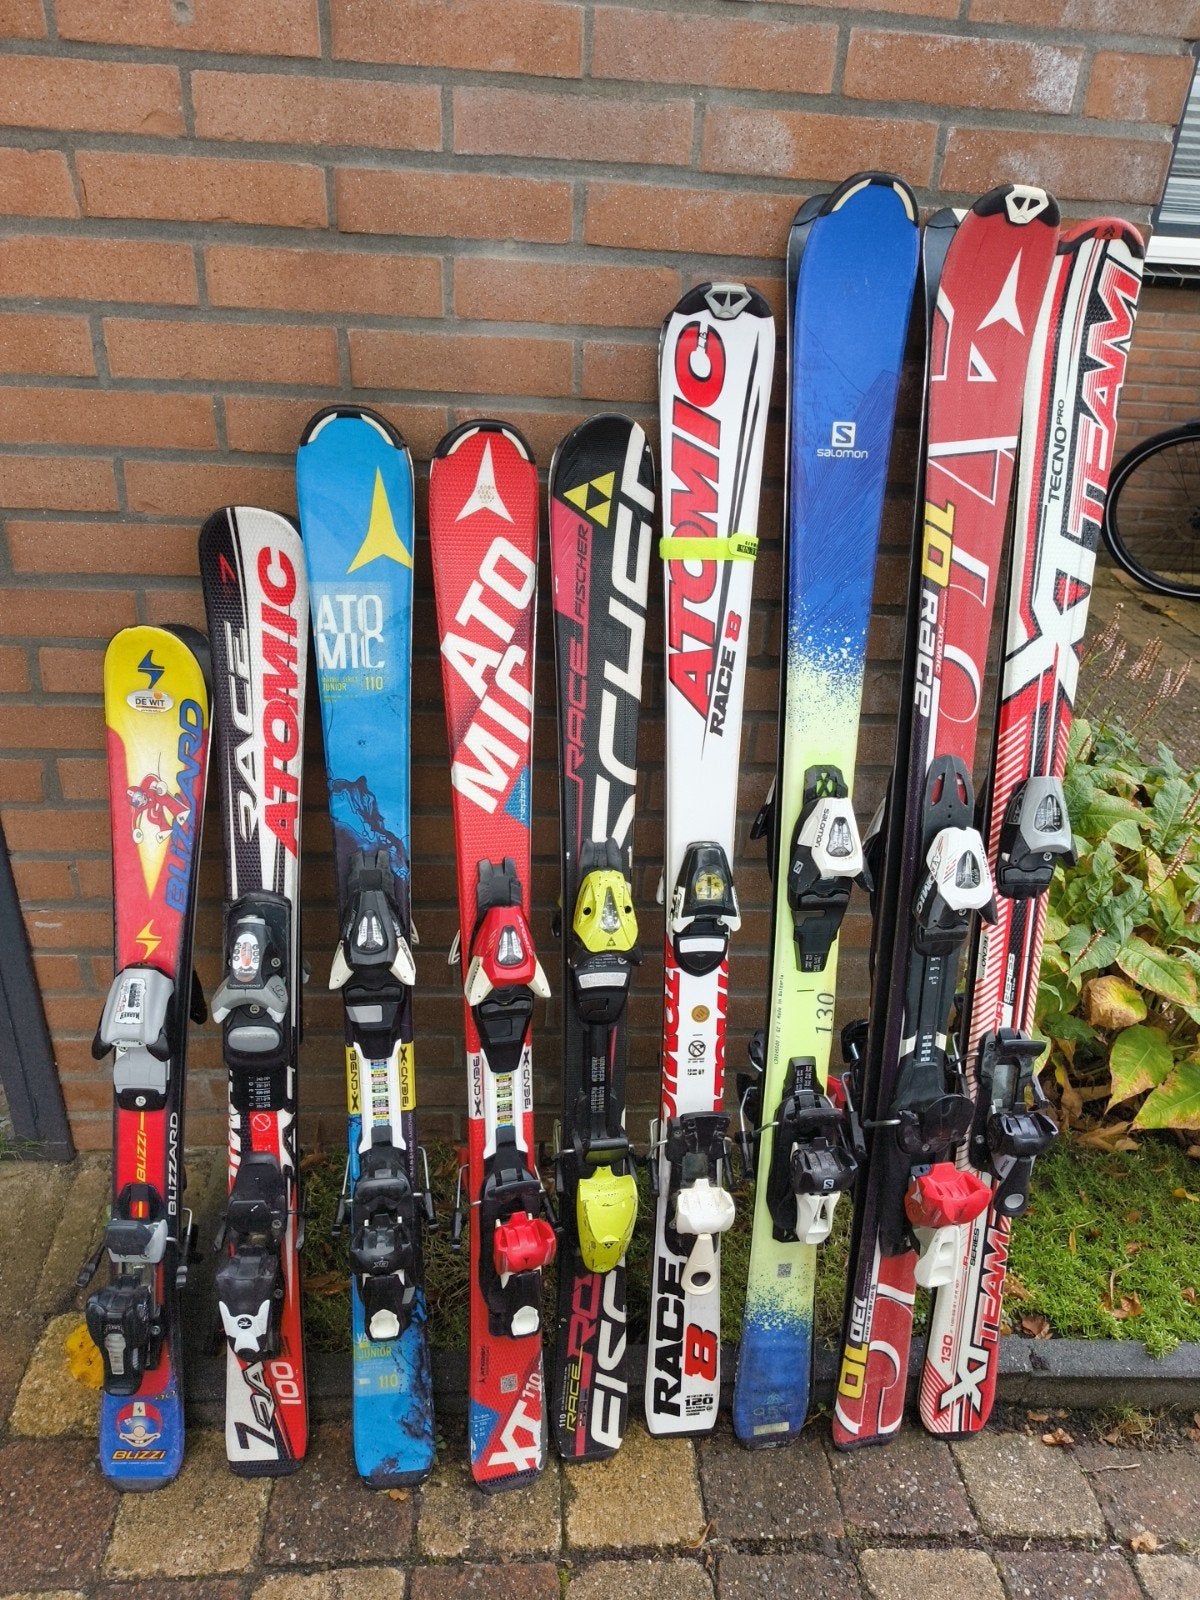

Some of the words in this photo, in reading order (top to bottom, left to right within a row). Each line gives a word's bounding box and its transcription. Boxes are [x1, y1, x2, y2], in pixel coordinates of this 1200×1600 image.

[1055, 398, 1066, 426] PRO
[1066, 266, 1144, 540] TEAM
[1047, 430, 1068, 503] TECNO
[668, 320, 727, 721] ATOMIC
[921, 500, 954, 588] 10
[576, 523, 590, 619] FISCHER
[314, 594, 384, 636] ATO
[441, 536, 537, 699] ATO
[317, 632, 385, 670] MIC
[934, 624, 945, 674] ATOMIC
[322, 682, 347, 692] JUNIOR
[365, 676, 384, 691] 110
[709, 644, 736, 737] RACE
[724, 610, 742, 641] 8
[150, 699, 165, 707] WIT
[257, 546, 299, 860] ATOMIC
[224, 621, 256, 843] RACE
[815, 991, 835, 1035] 130
[969, 1228, 980, 1267] SERIES
[976, 1225, 1011, 1347] TEAM
[652, 1256, 687, 1418] RACE
[684, 1322, 718, 1382] 8
[848, 1295, 866, 1343] 130
[359, 1347, 392, 1360] JUNIOR
[837, 1341, 869, 1399] 10
[941, 1335, 952, 1364] 130
[270, 1361, 302, 1405] 100
[379, 1374, 399, 1389] 110
[521, 1372, 542, 1401] 110
[566, 1360, 582, 1433] RACE
[684, 1397, 714, 1407] 120
[558, 1413, 566, 1428] 110
